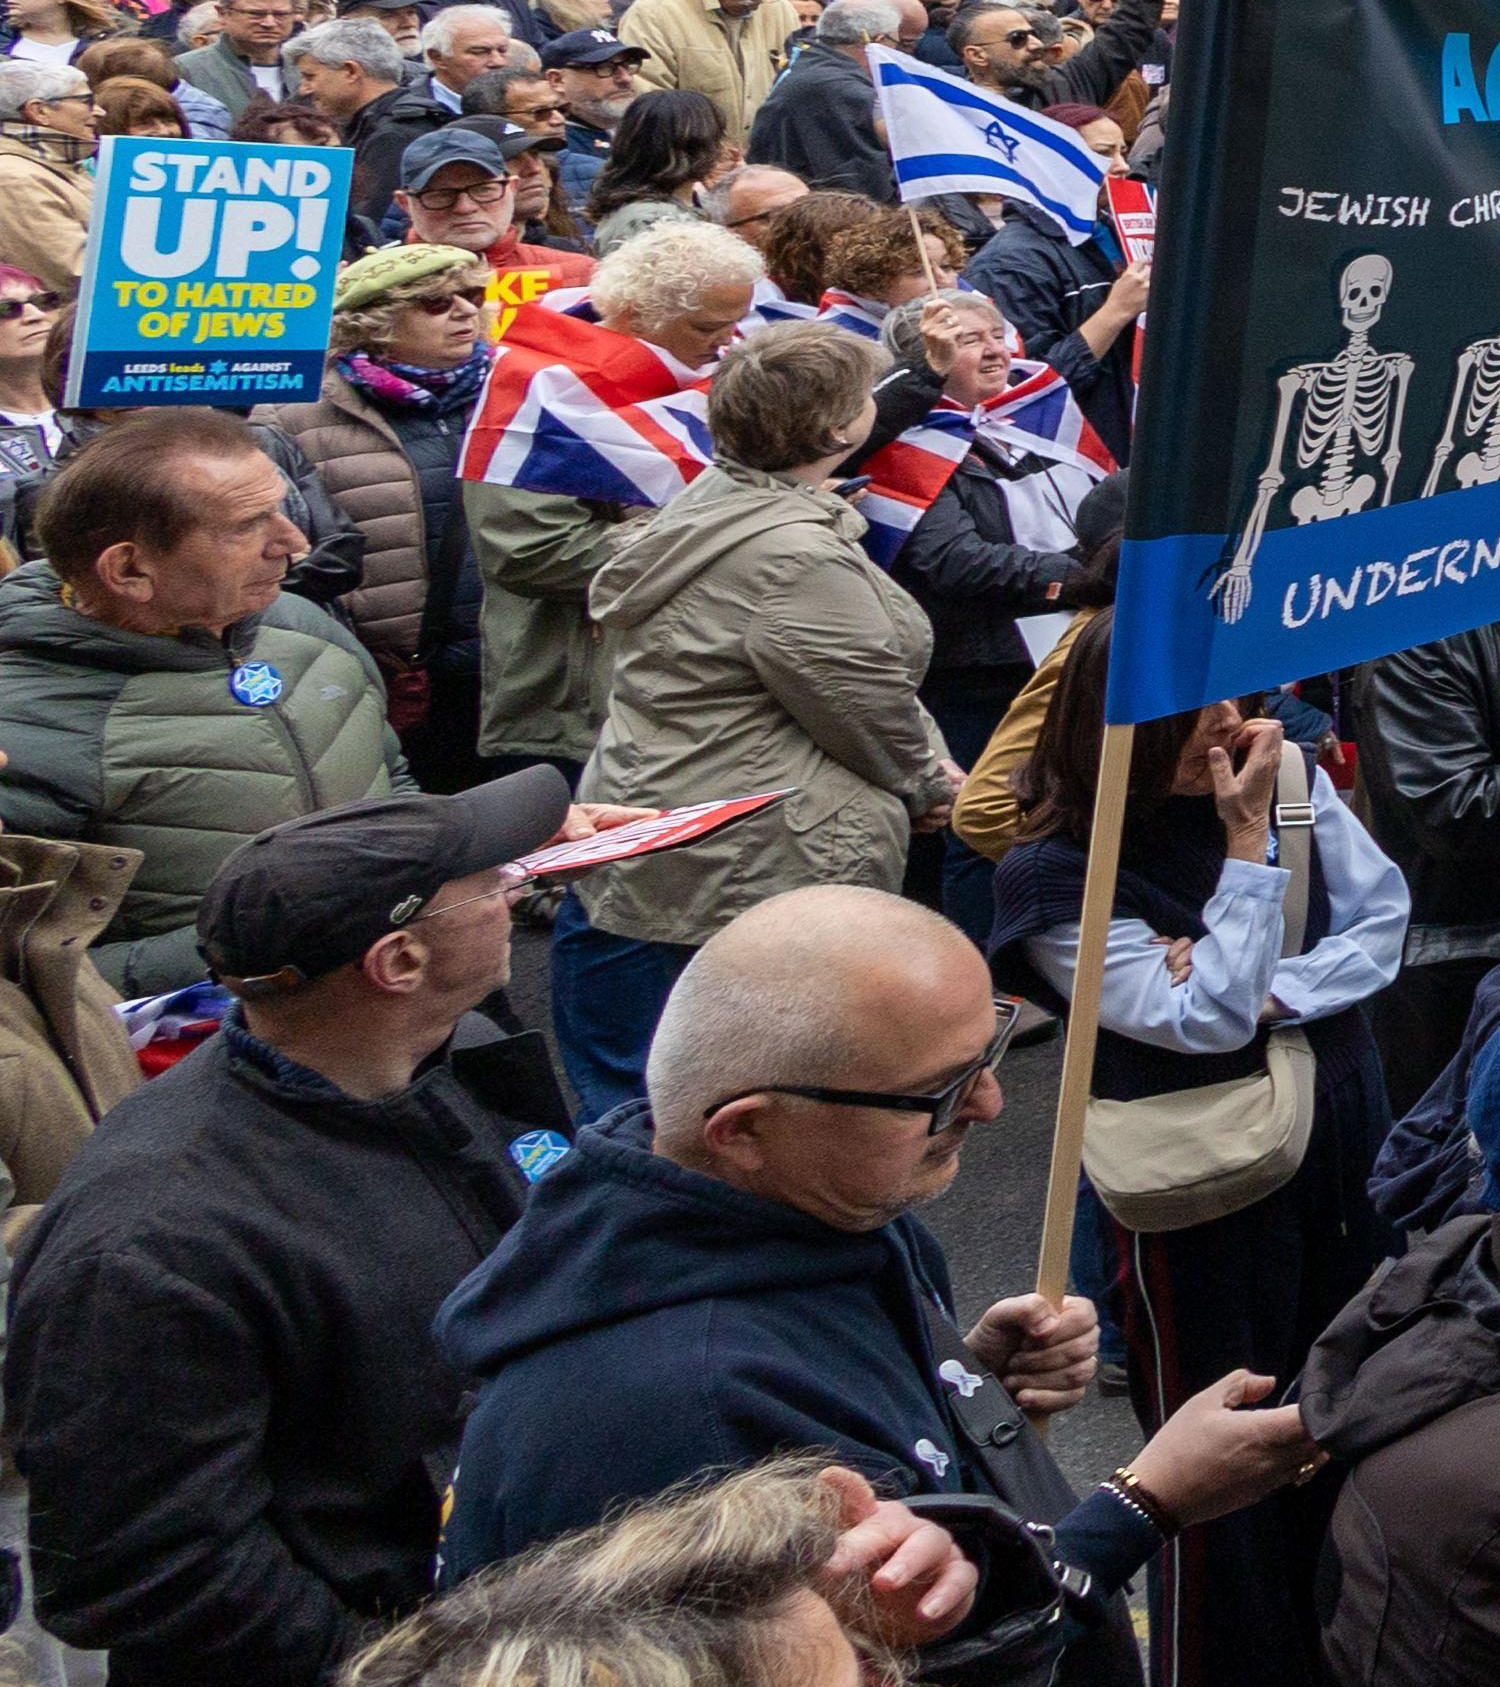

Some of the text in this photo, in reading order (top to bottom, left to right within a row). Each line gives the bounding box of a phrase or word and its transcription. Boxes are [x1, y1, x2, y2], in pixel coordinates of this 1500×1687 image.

[130, 152, 331, 197] STAND
[1278, 187, 1431, 228] JEWISH
[120, 196, 329, 280] UP!
[113, 281, 316, 308] TO HATRED
[137, 312, 285, 343] OF JEWS
[101, 374, 303, 393] ANTISEMITISM
[124, 362, 291, 374] LEEDS leads AGAINST
